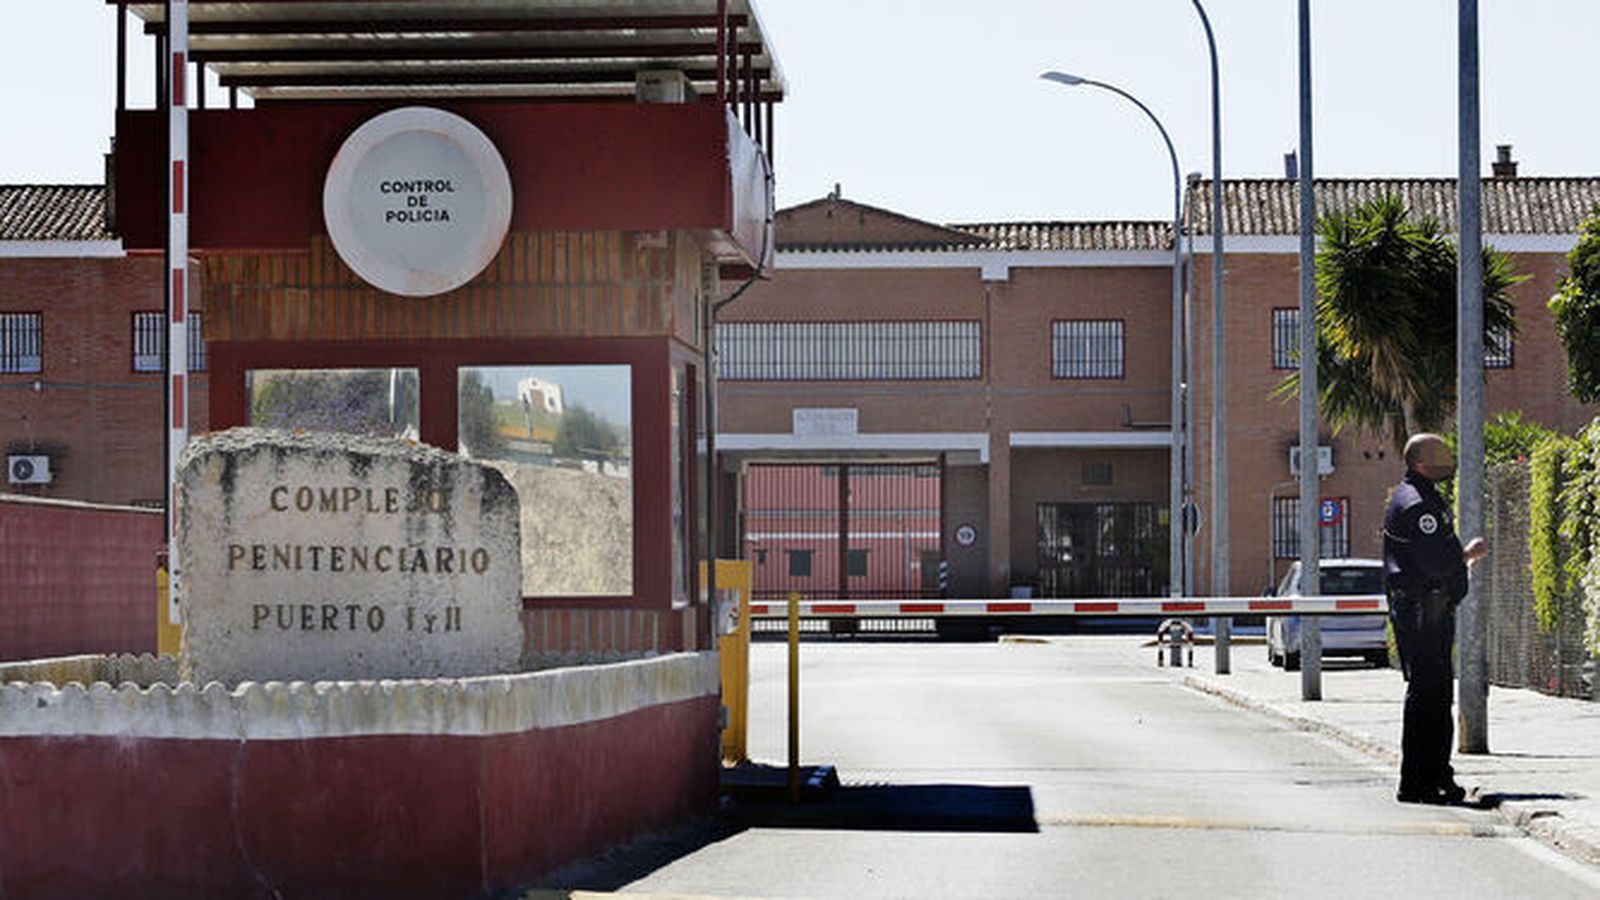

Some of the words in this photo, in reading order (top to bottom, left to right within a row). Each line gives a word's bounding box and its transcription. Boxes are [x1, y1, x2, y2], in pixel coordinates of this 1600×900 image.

[380, 180, 454, 193] CONTROL
[407, 195, 428, 207] DE
[385, 210, 450, 223] POLICIA
[270, 486, 449, 513] COMPLEJO
[227, 544, 490, 575] PENITENCIARIO
[252, 604, 385, 632] PUERTO
